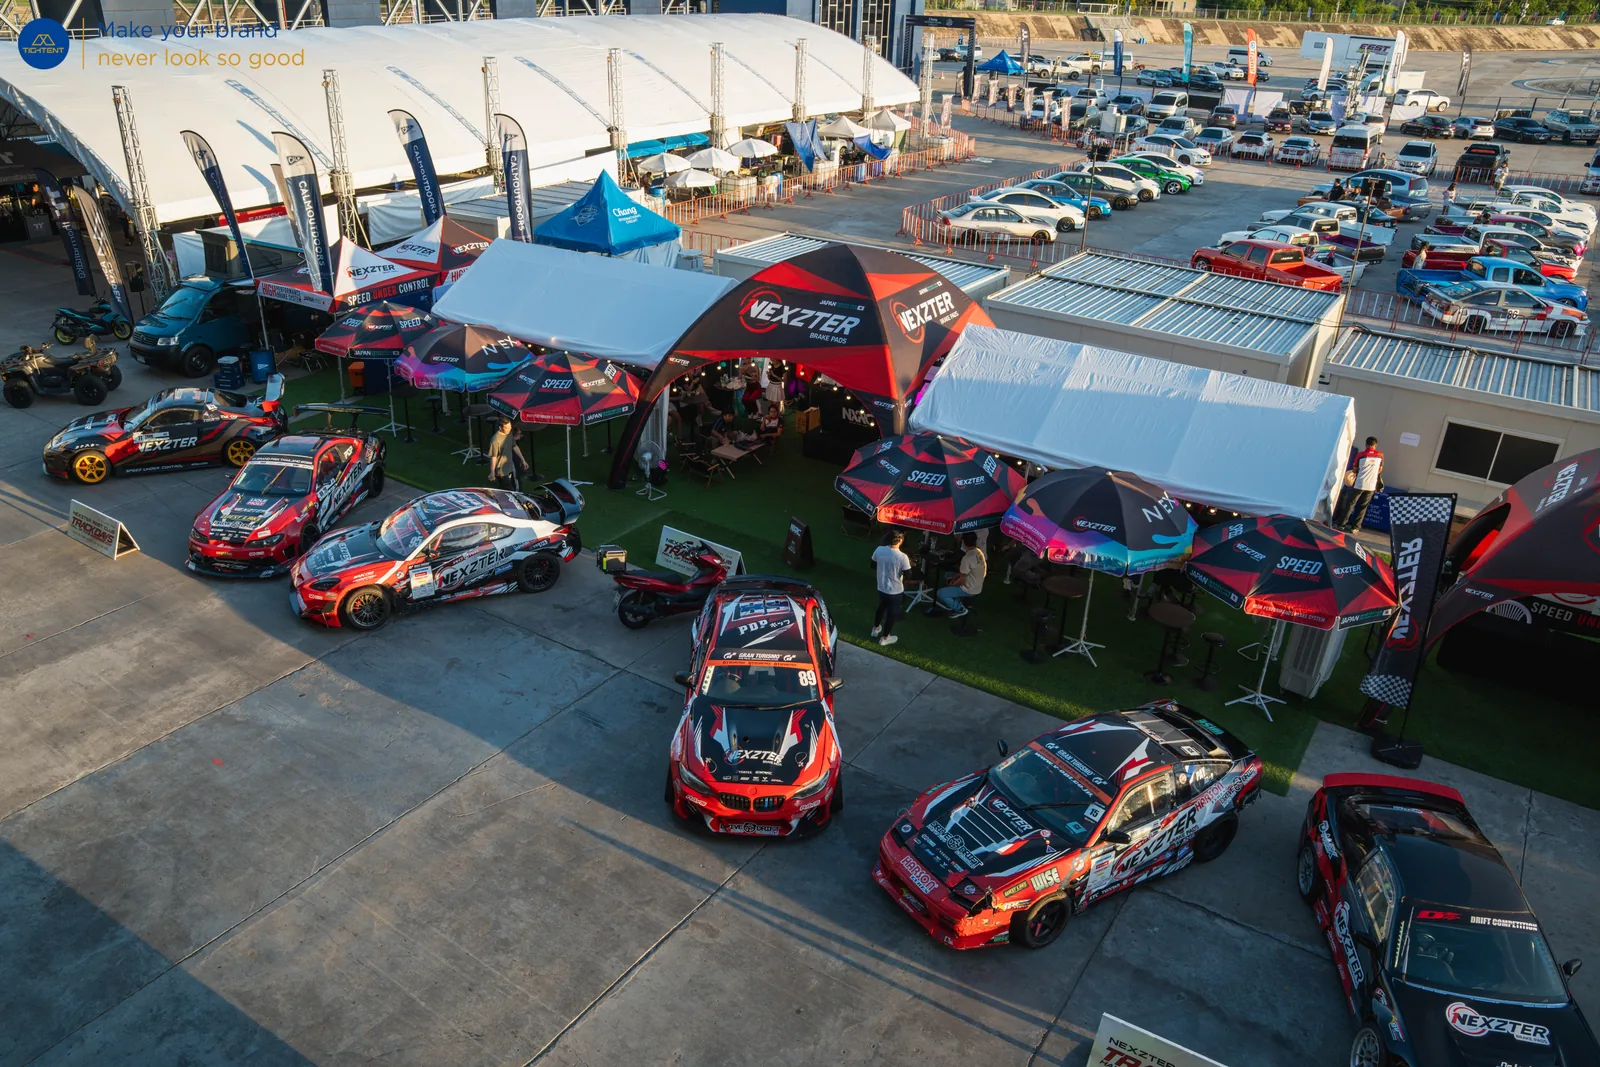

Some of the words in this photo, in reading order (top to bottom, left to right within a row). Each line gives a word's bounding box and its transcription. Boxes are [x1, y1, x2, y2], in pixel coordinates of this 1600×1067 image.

[413, 144, 438, 214] CALMOUTDOORS
[510, 155, 525, 231] CALMOUTDOORS
[612, 206, 638, 217] Chang
[298, 180, 325, 267] CALMOUTDOORS
[399, 243, 436, 256] NEXZTER
[452, 241, 490, 255] NEXZTER
[347, 264, 396, 278] NEXZTER
[347, 292, 371, 307] SPEED
[372, 285, 397, 300] UNDER
[398, 278, 430, 294] CONTROL
[819, 299, 837, 307] JAPAN
[750, 300, 860, 335] NEXZTER
[899, 291, 955, 332] NEXZTER
[399, 317, 421, 329] SPEED
[809, 332, 830, 341] BRAKE
[831, 335, 848, 344] PADS
[541, 378, 574, 390] SPEED
[587, 412, 603, 421] JAPAN
[138, 436, 198, 453] NEXZTER
[907, 470, 947, 487] SPEED
[956, 475, 985, 487] NEXZTER
[960, 521, 978, 530] JAPAN
[1075, 520, 1117, 533] NEXZTER
[408, 535, 423, 548] 95
[1235, 542, 1266, 561] NEXZTER
[438, 547, 506, 589] NEXZTER
[1276, 555, 1323, 575] SPEED
[1333, 564, 1362, 575] NEXZTER
[1190, 569, 1209, 585] JAPAN
[1465, 587, 1494, 599] NEXZTER
[1340, 614, 1360, 625] JAPAN
[1531, 601, 1573, 622] SPEED
[755, 652, 781, 660] TURISMO
[798, 669, 817, 687] 89
[727, 749, 784, 763] NEXZTER
[1057, 749, 1073, 761] GRAN
[1071, 758, 1094, 776] TURISMO
[1195, 782, 1224, 812] HARSON
[992, 798, 1034, 831] NEXZTER
[1089, 808, 1100, 818] 15
[1117, 807, 1197, 874] NEXZTER
[901, 855, 937, 891] HARSON
[1031, 867, 1061, 892] WISE
[1470, 915, 1491, 925] DRIFT
[1492, 918, 1538, 931] COMPETITION
[1335, 911, 1363, 982] NEXZTER
[1452, 1012, 1548, 1039] NEXZTER
